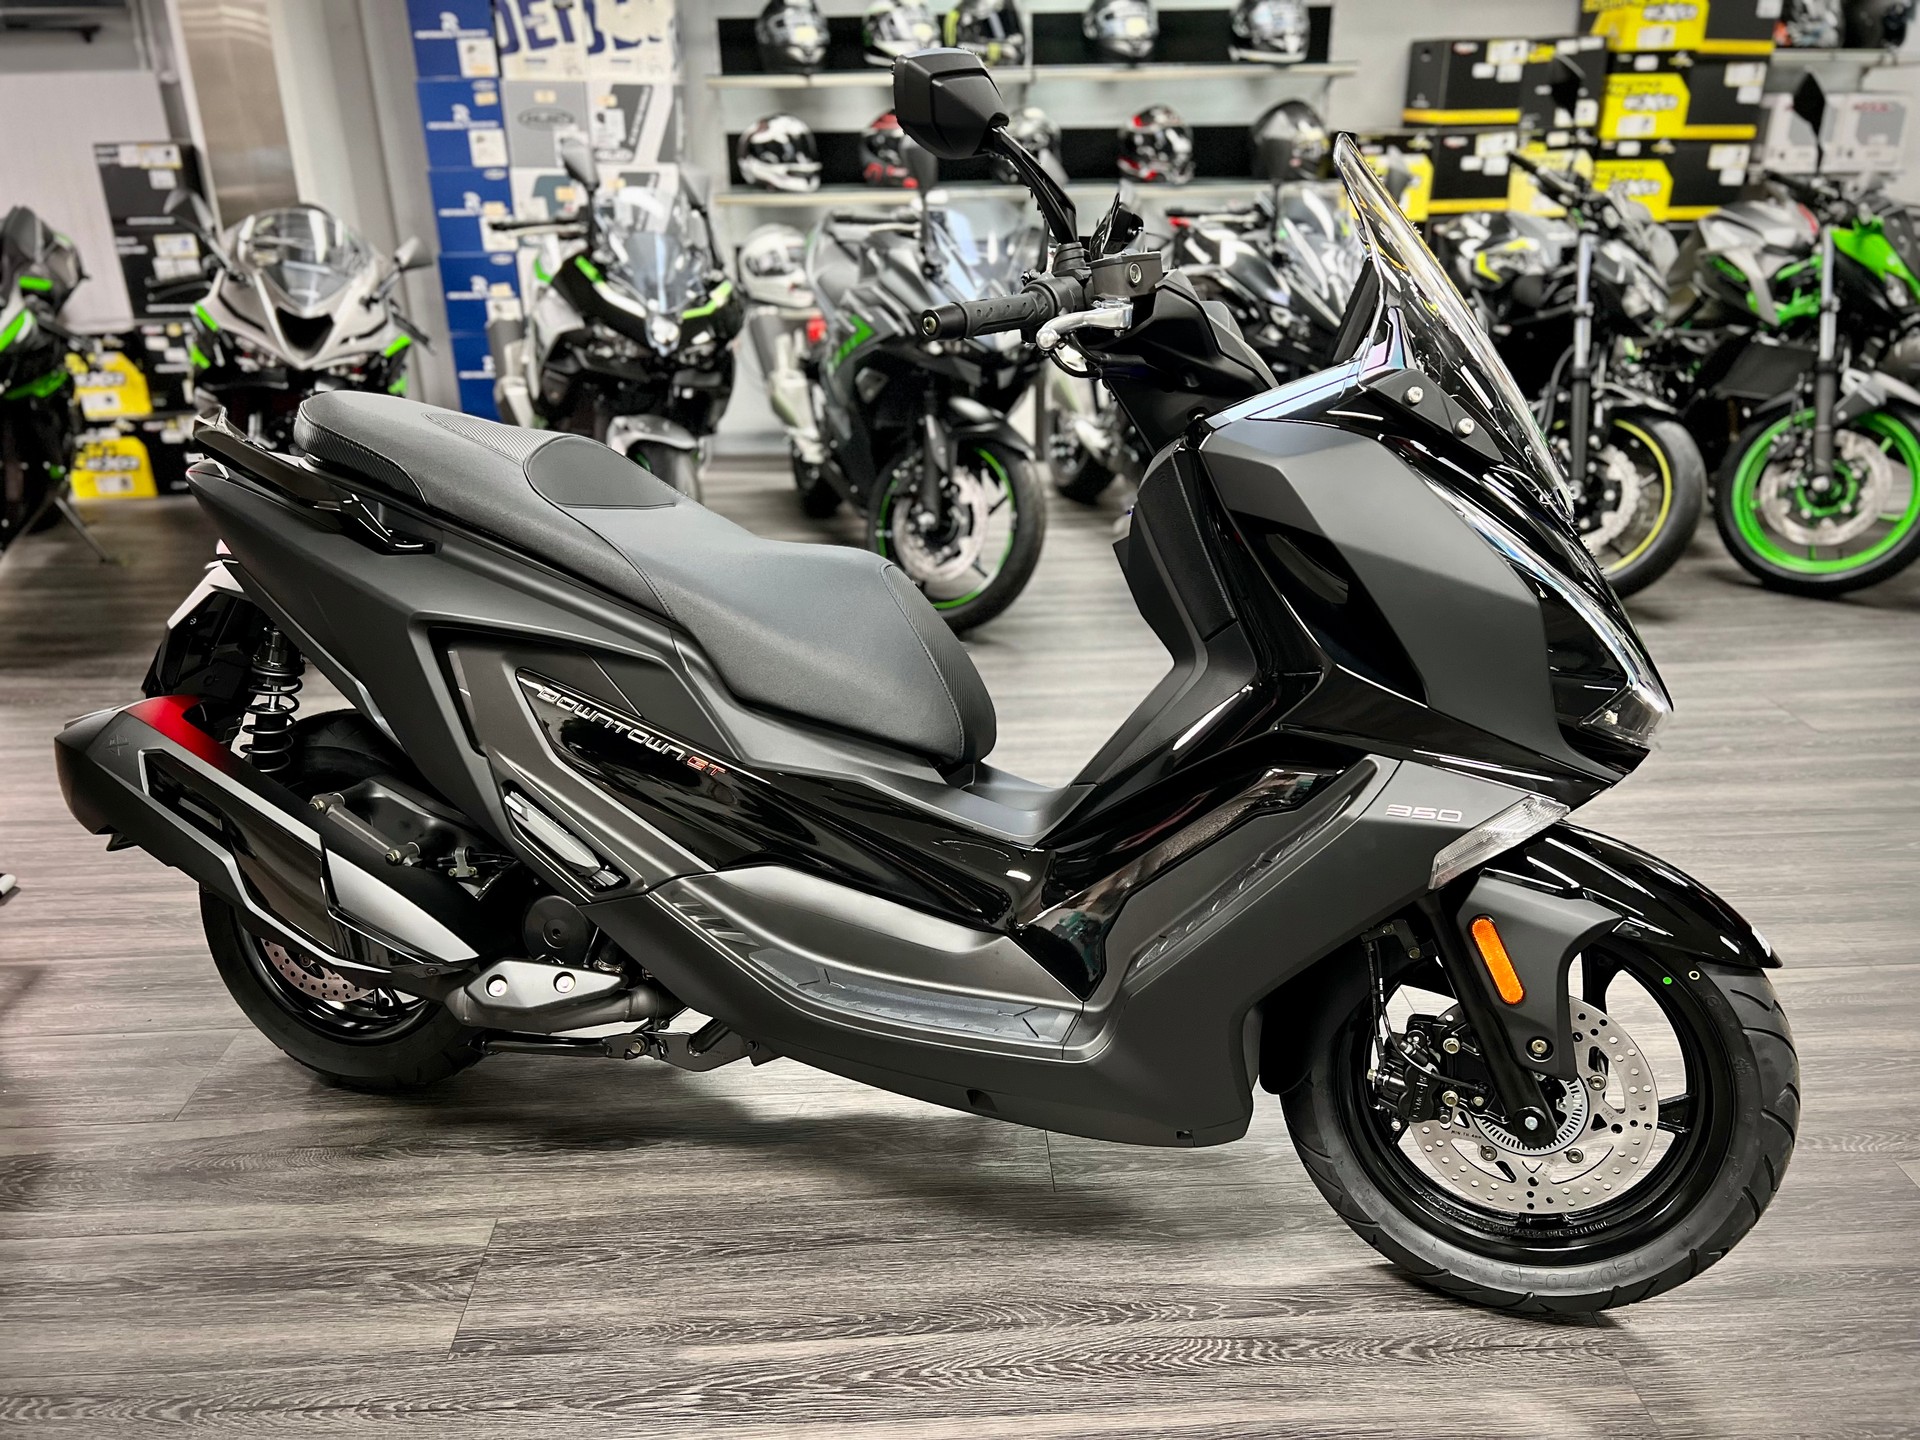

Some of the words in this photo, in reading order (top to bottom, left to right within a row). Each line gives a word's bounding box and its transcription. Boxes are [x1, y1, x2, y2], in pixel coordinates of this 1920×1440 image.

[536, 686, 687, 761] DOWNTOWN
[686, 755, 727, 776] GT
[1385, 803, 1463, 823] 350
